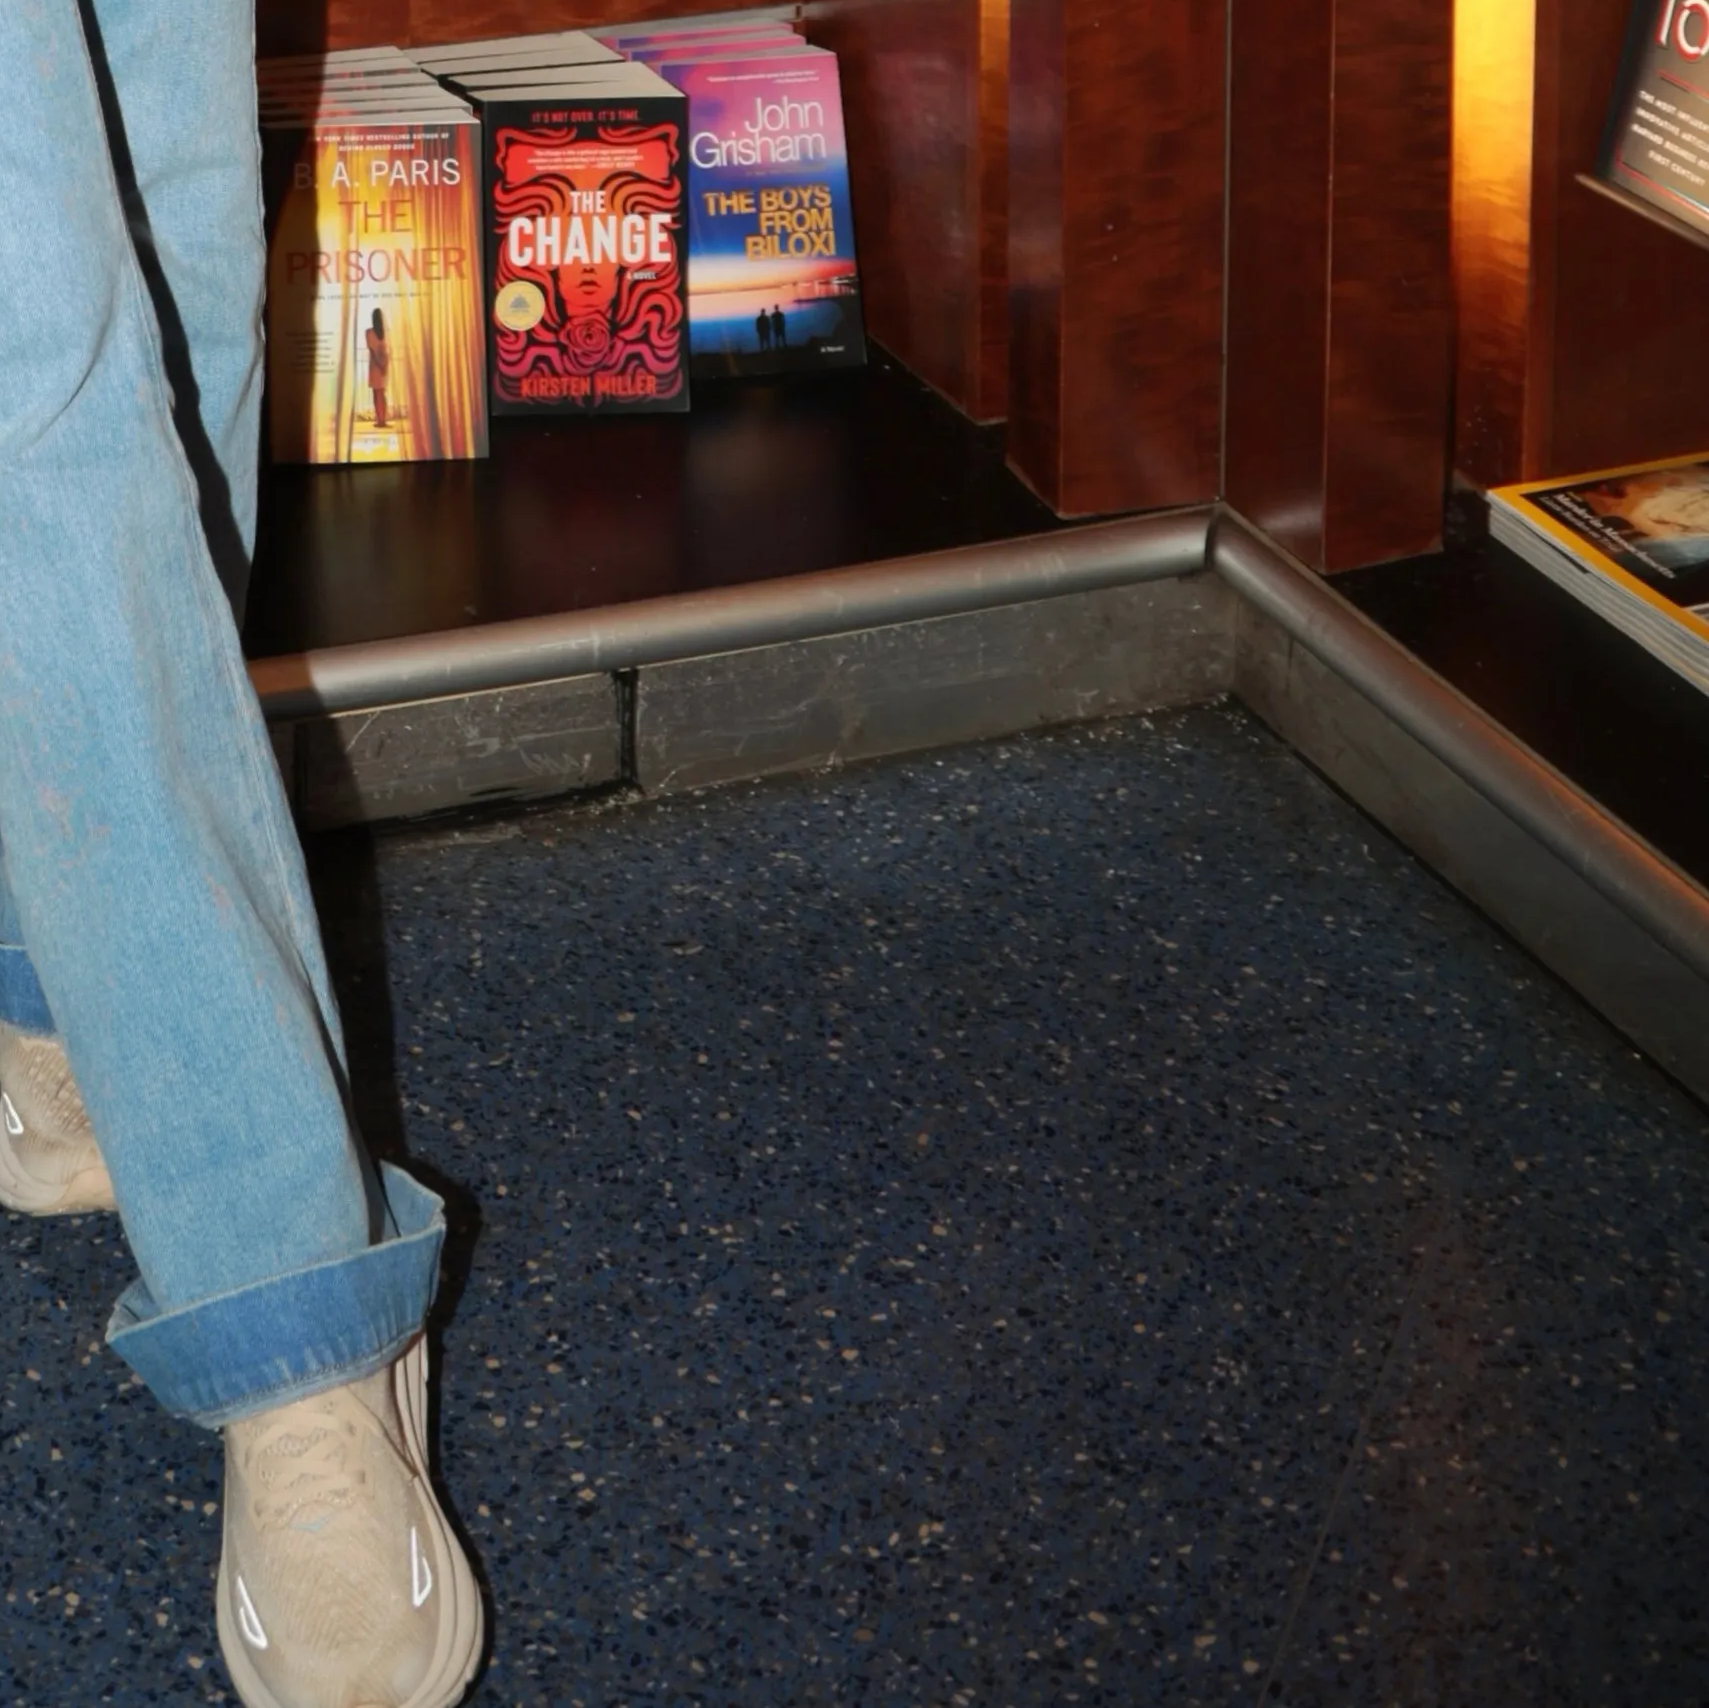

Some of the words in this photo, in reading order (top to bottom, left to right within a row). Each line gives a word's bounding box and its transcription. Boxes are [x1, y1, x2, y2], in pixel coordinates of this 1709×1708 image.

[745, 96, 824, 133] John
[691, 130, 826, 169] Grisham
[508, 212, 672, 268] CHANGE
